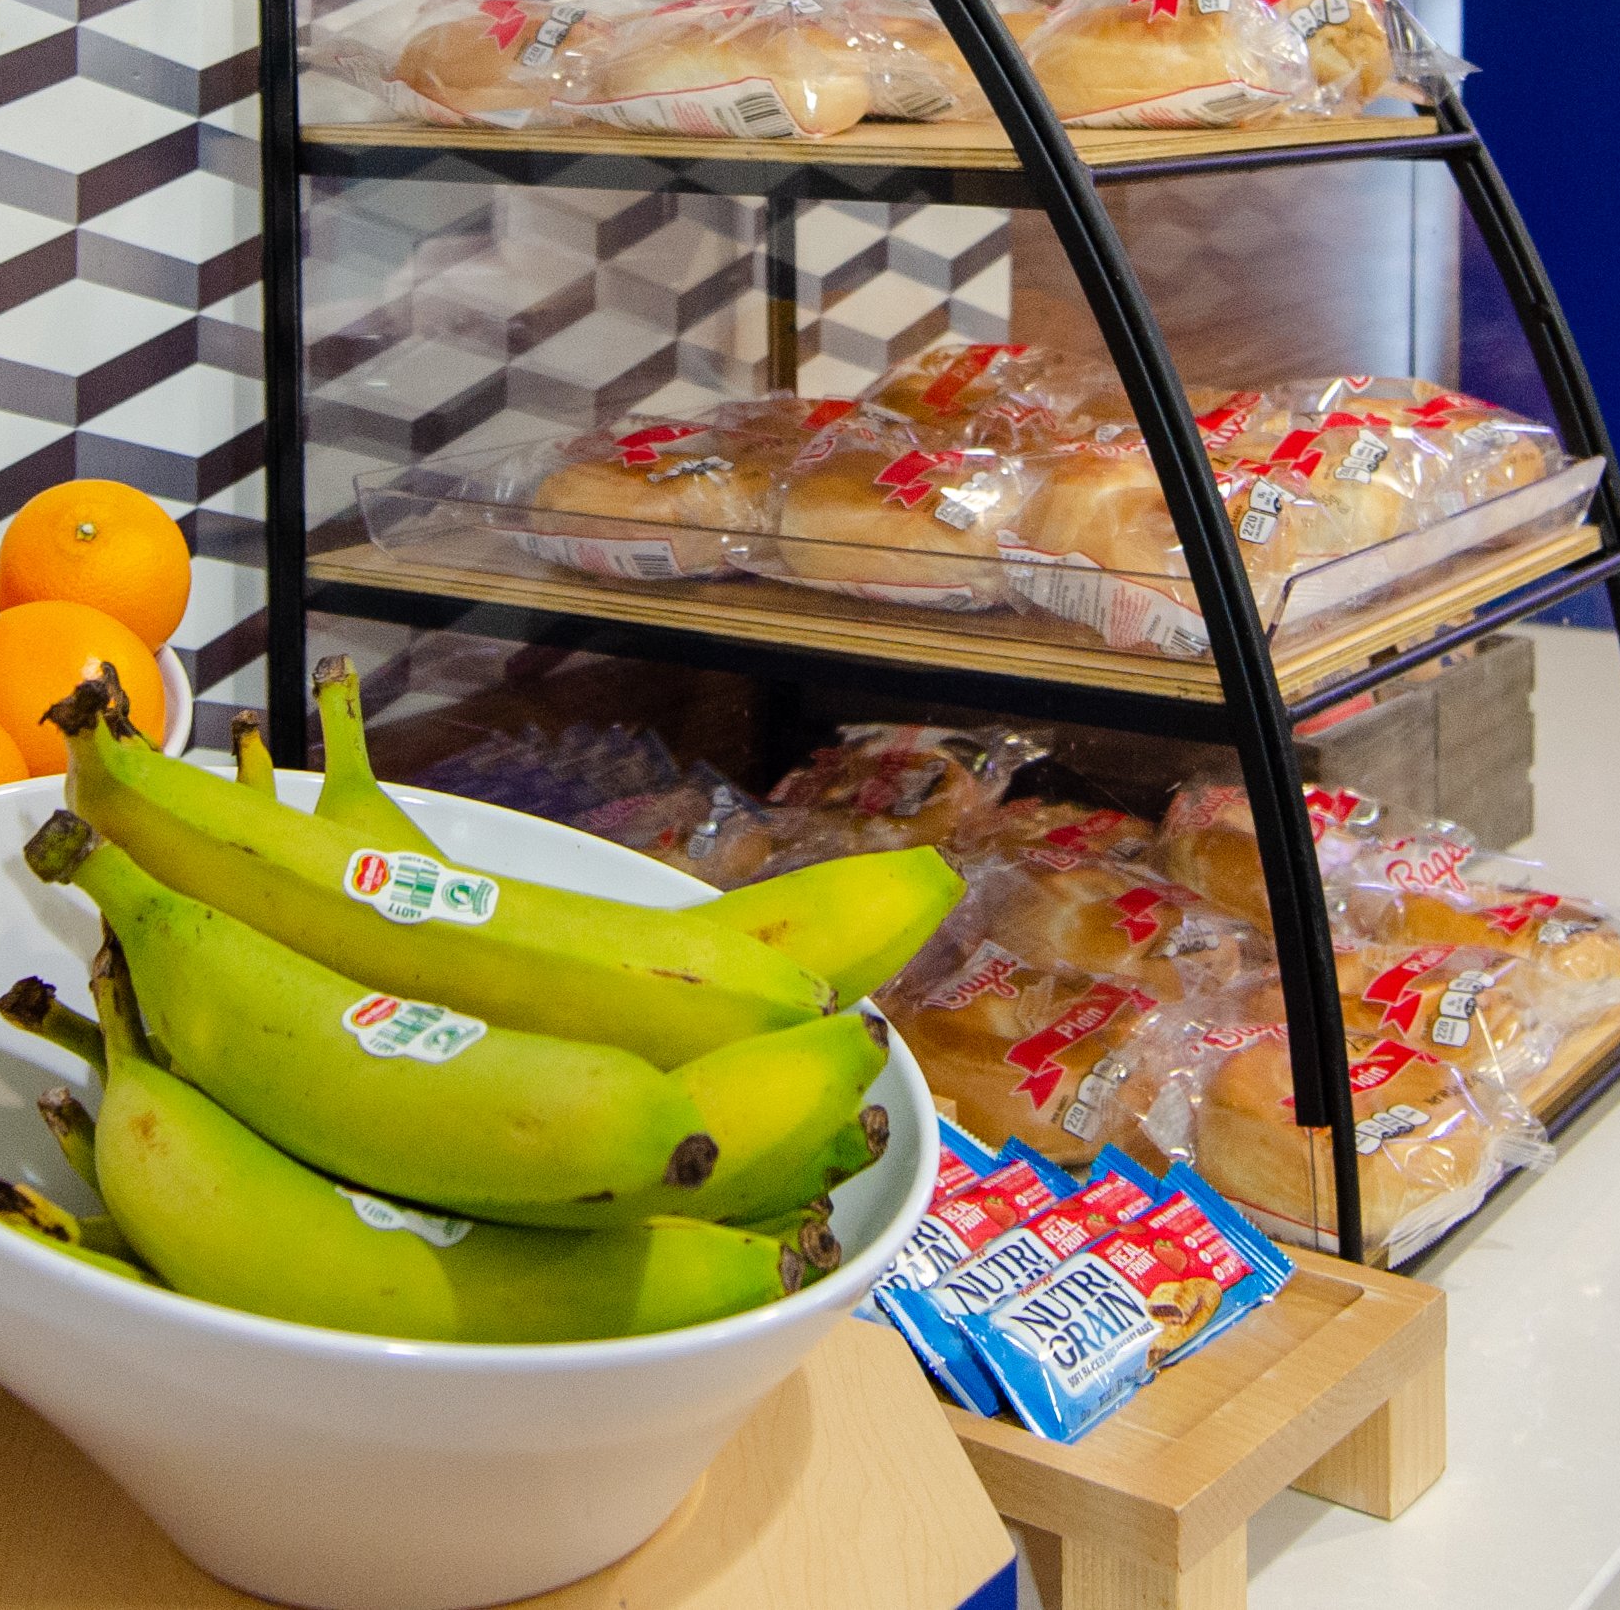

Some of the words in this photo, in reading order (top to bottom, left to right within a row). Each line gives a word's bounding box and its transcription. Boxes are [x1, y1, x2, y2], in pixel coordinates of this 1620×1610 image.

[1241, 514, 1257, 539] 220
[1054, 1006, 1104, 1040] Plain
[1351, 1066, 1390, 1089] lain
[1066, 1106, 1085, 1129] 220
[940, 1200, 978, 1223] REAL
[955, 1206, 988, 1235] FRUIT
[1041, 1216, 1078, 1246] REAL
[1055, 1224, 1091, 1257] FRUIT
[1108, 1241, 1145, 1270] REAL
[1125, 1250, 1158, 1280] FRUIT
[944, 1236, 1045, 1315] NUTRI
[1009, 1262, 1114, 1343] NUTRI
[1048, 1281, 1146, 1369] GRAIN
